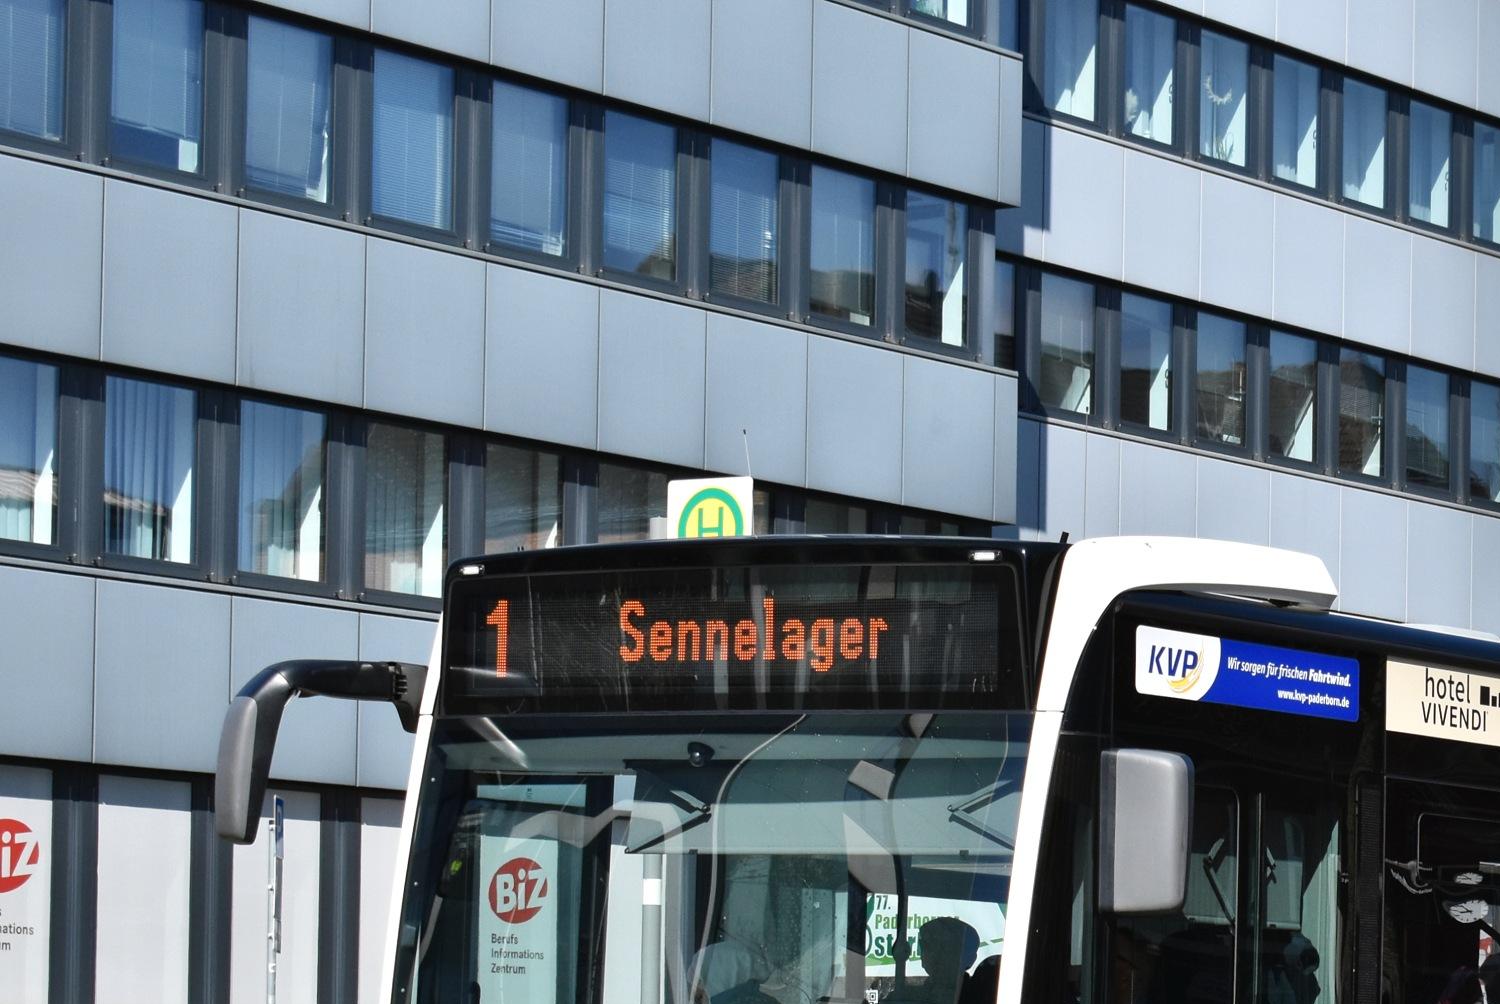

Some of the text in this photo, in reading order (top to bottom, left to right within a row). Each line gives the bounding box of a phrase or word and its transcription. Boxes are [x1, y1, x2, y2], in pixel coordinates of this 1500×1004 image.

[698, 506, 724, 538] H
[486, 596, 889, 678] 1 Sennelager
[1148, 644, 1200, 679] KVP
[1227, 656, 1352, 688] Wir sorgen für frischen Fahrtwind.
[1277, 688, 1350, 709] www.kvp-paderborn.de
[1425, 667, 1471, 704] hotel
[1421, 701, 1487, 732] VIVENDI
[0, 830, 39, 878] iZ
[496, 867, 549, 915] BiZ
[875, 894, 892, 911] 77.
[0, 923, 35, 936] ations
[491, 933, 519, 945] Berufs
[491, 948, 544, 961] Informations
[491, 963, 526, 975] Zentrum
